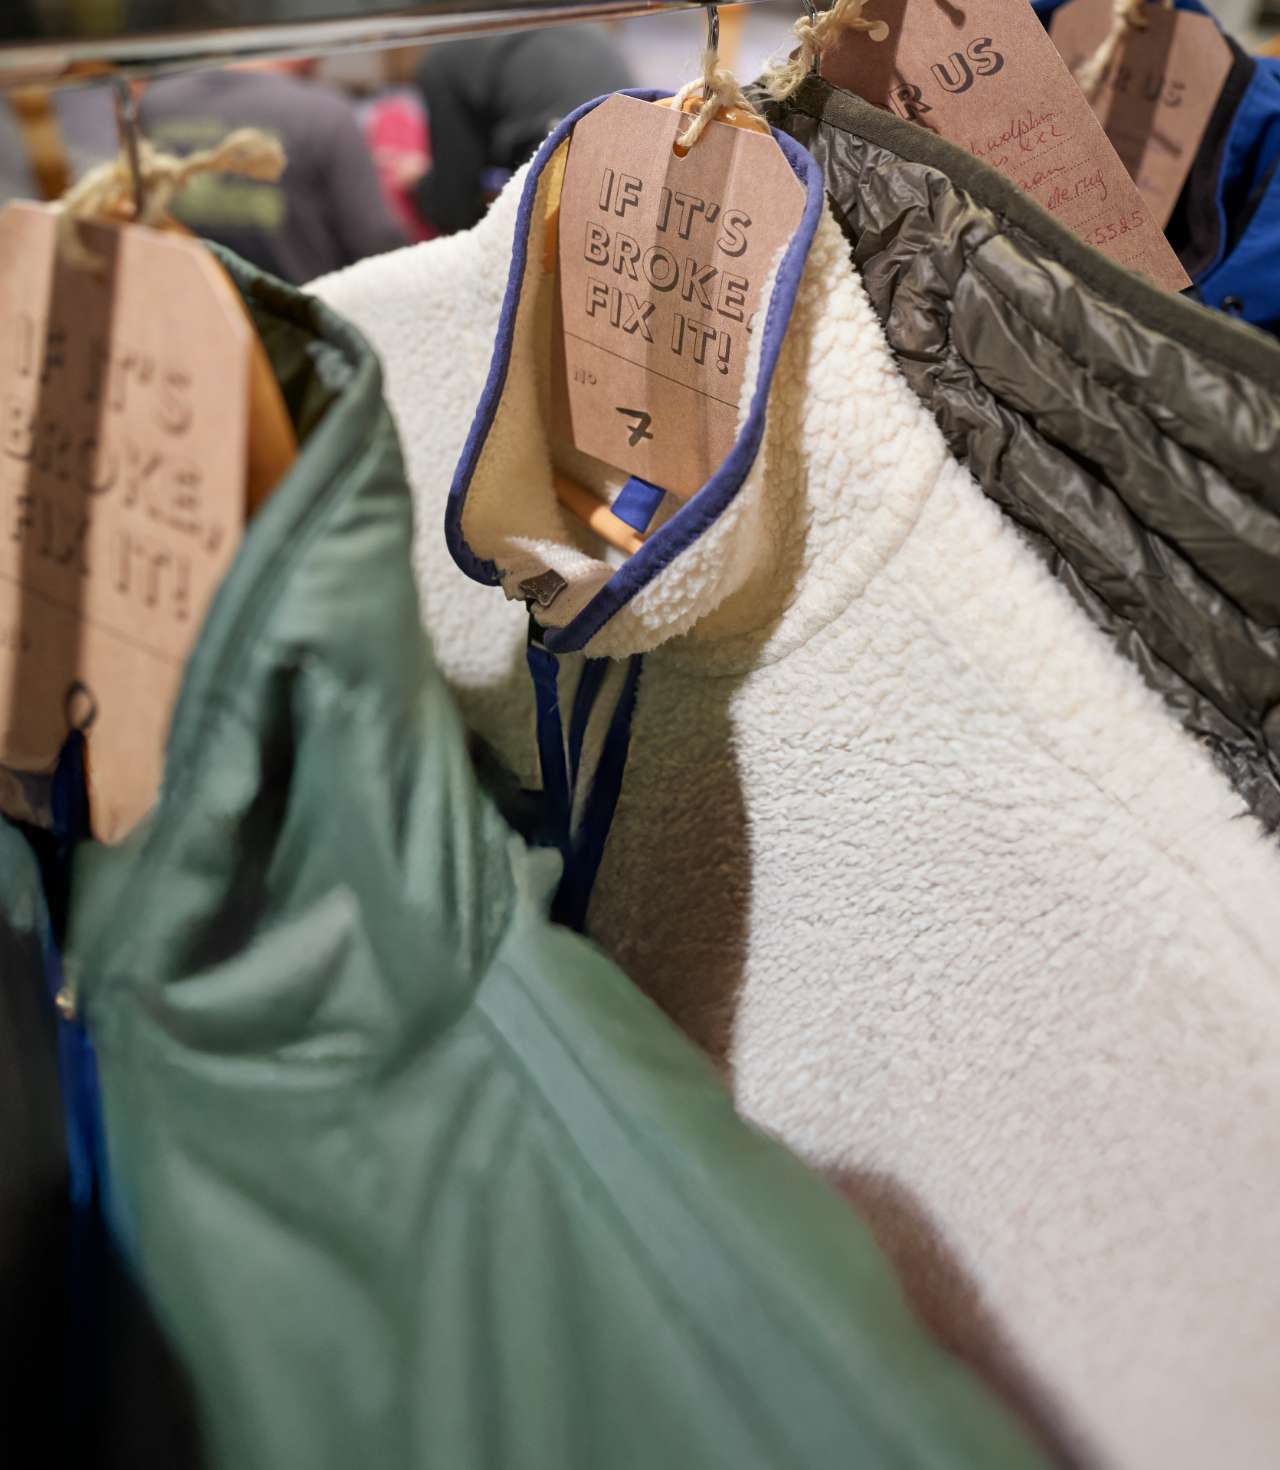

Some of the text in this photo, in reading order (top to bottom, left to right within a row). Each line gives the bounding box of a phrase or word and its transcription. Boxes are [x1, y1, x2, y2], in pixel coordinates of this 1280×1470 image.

[930, 37, 1004, 94] US
[599, 168, 752, 257] IF IT'S
[585, 276, 732, 375] FIX IT!
[615, 406, 654, 448] 7
